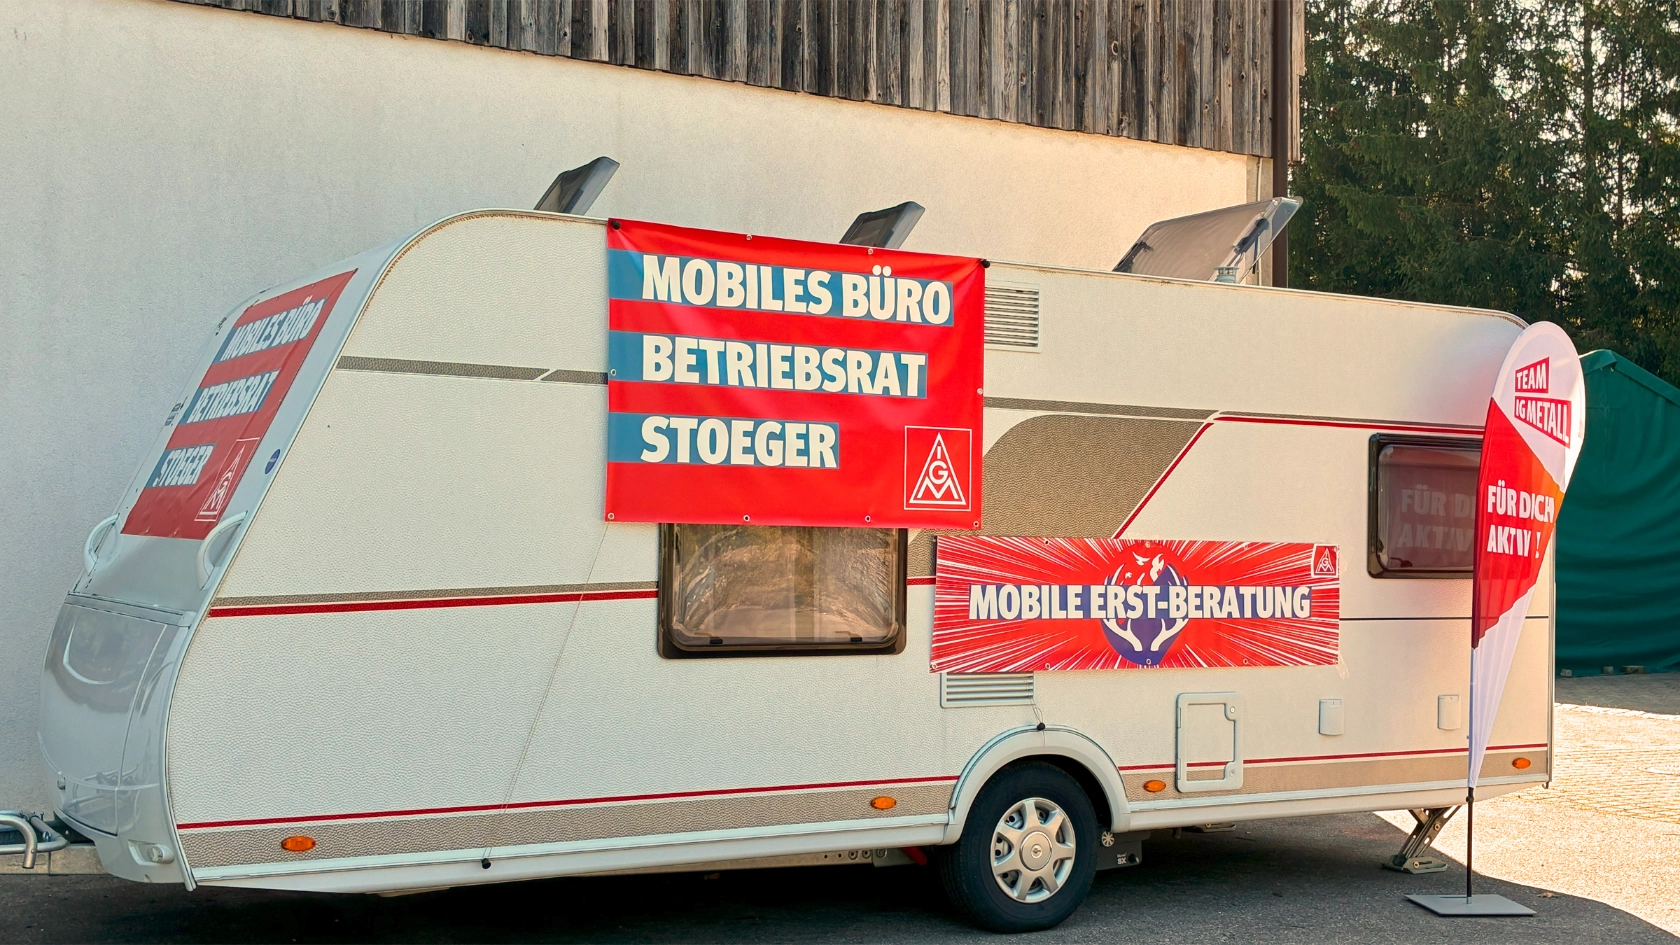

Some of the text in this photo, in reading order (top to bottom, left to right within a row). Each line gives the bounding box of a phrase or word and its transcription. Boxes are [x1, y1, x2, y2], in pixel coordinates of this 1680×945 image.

[641, 254, 952, 325] MOBILES BÜRO
[220, 295, 325, 361] MOBILES BÜRO
[642, 335, 926, 397] BETRIEBSRAT
[1516, 362, 1547, 390] TEAM
[186, 370, 280, 424] BETRIEBSRAT
[640, 416, 837, 468] STOEGER
[1515, 398, 1570, 444] IG METALL
[152, 445, 214, 488] STOEGER
[915, 444, 961, 500] IGM
[1401, 483, 1447, 517] FÜR
[1487, 479, 1555, 524] FÜR DICH
[1486, 524, 1532, 557] AKTIV
[969, 584, 1311, 620] MOBILE ERST-BERATUNG
